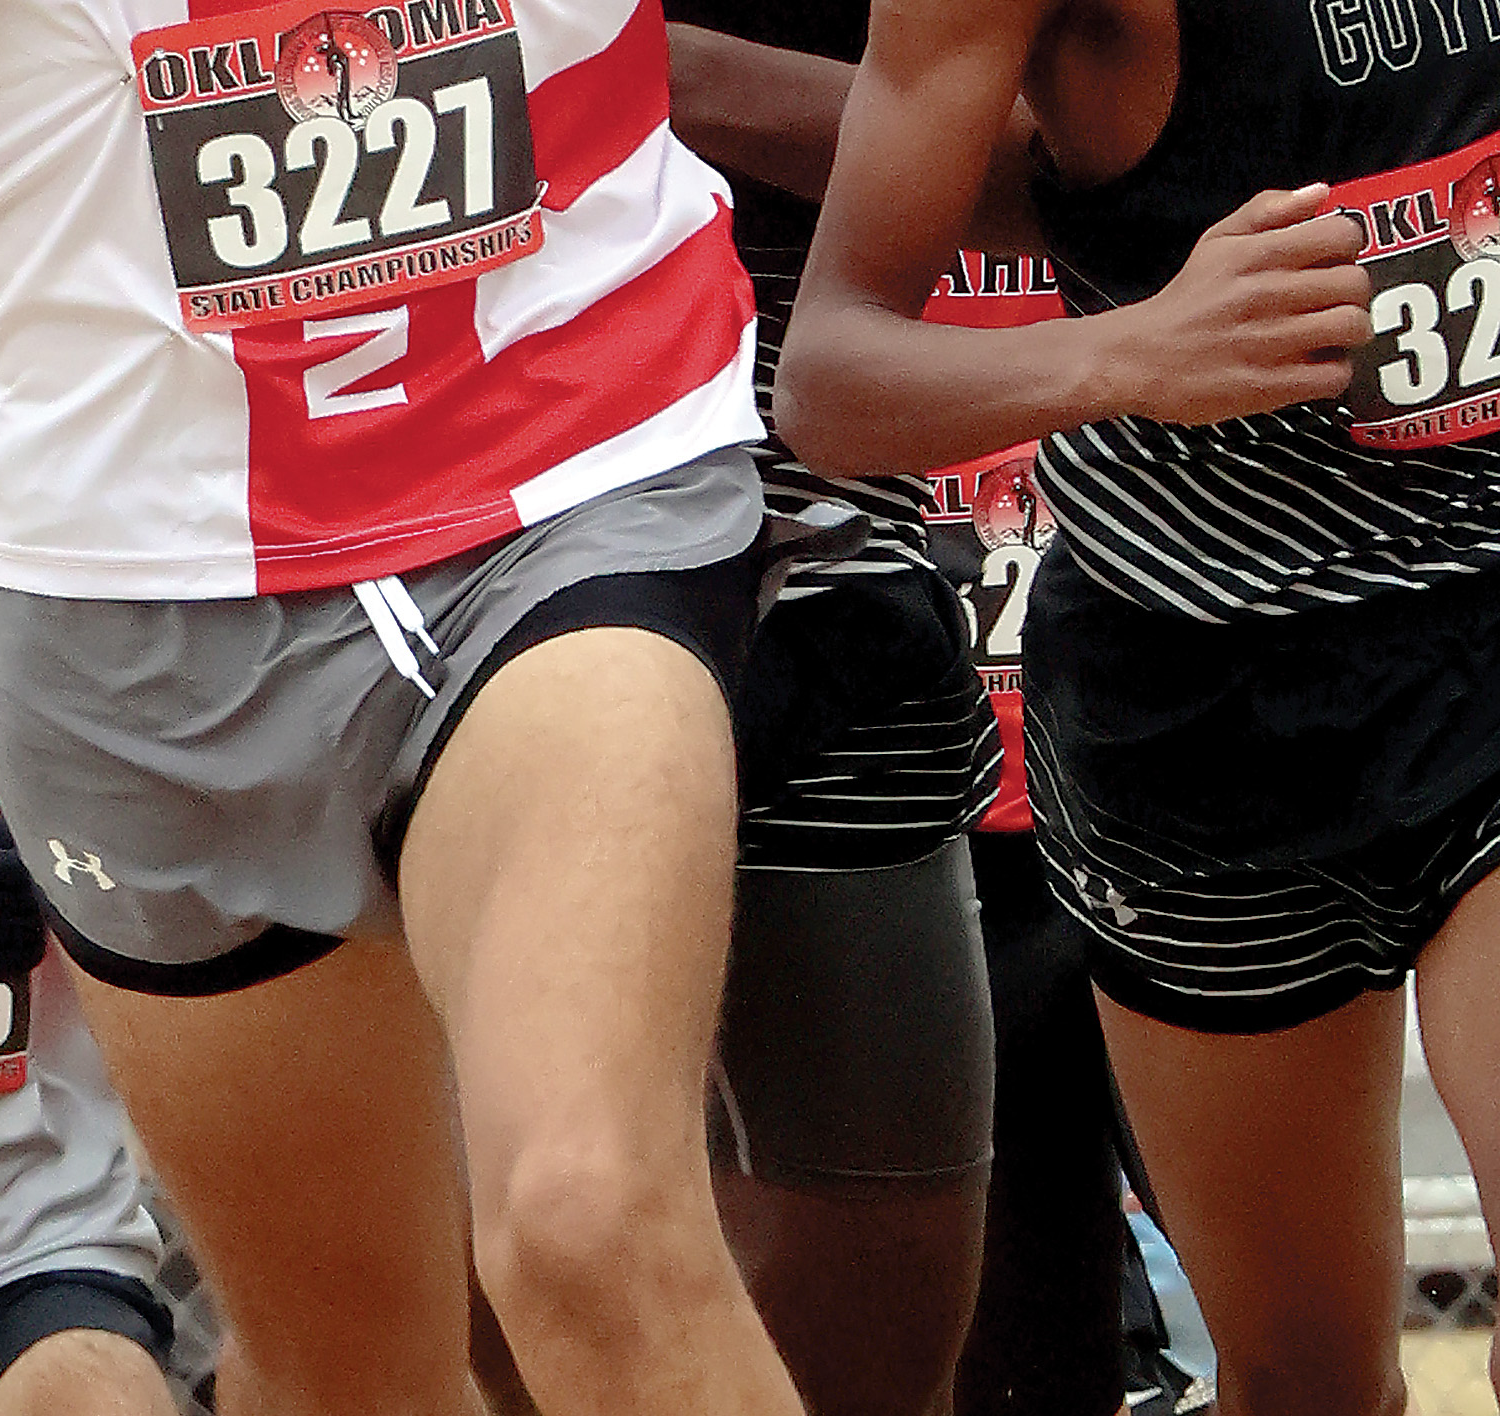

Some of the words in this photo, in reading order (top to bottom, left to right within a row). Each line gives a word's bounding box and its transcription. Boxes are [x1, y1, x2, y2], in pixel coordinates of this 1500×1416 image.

[197, 76, 494, 269] 3227
[190, 284, 286, 318] STATE
[292, 219, 534, 303] CHAMPIONSHIPS
